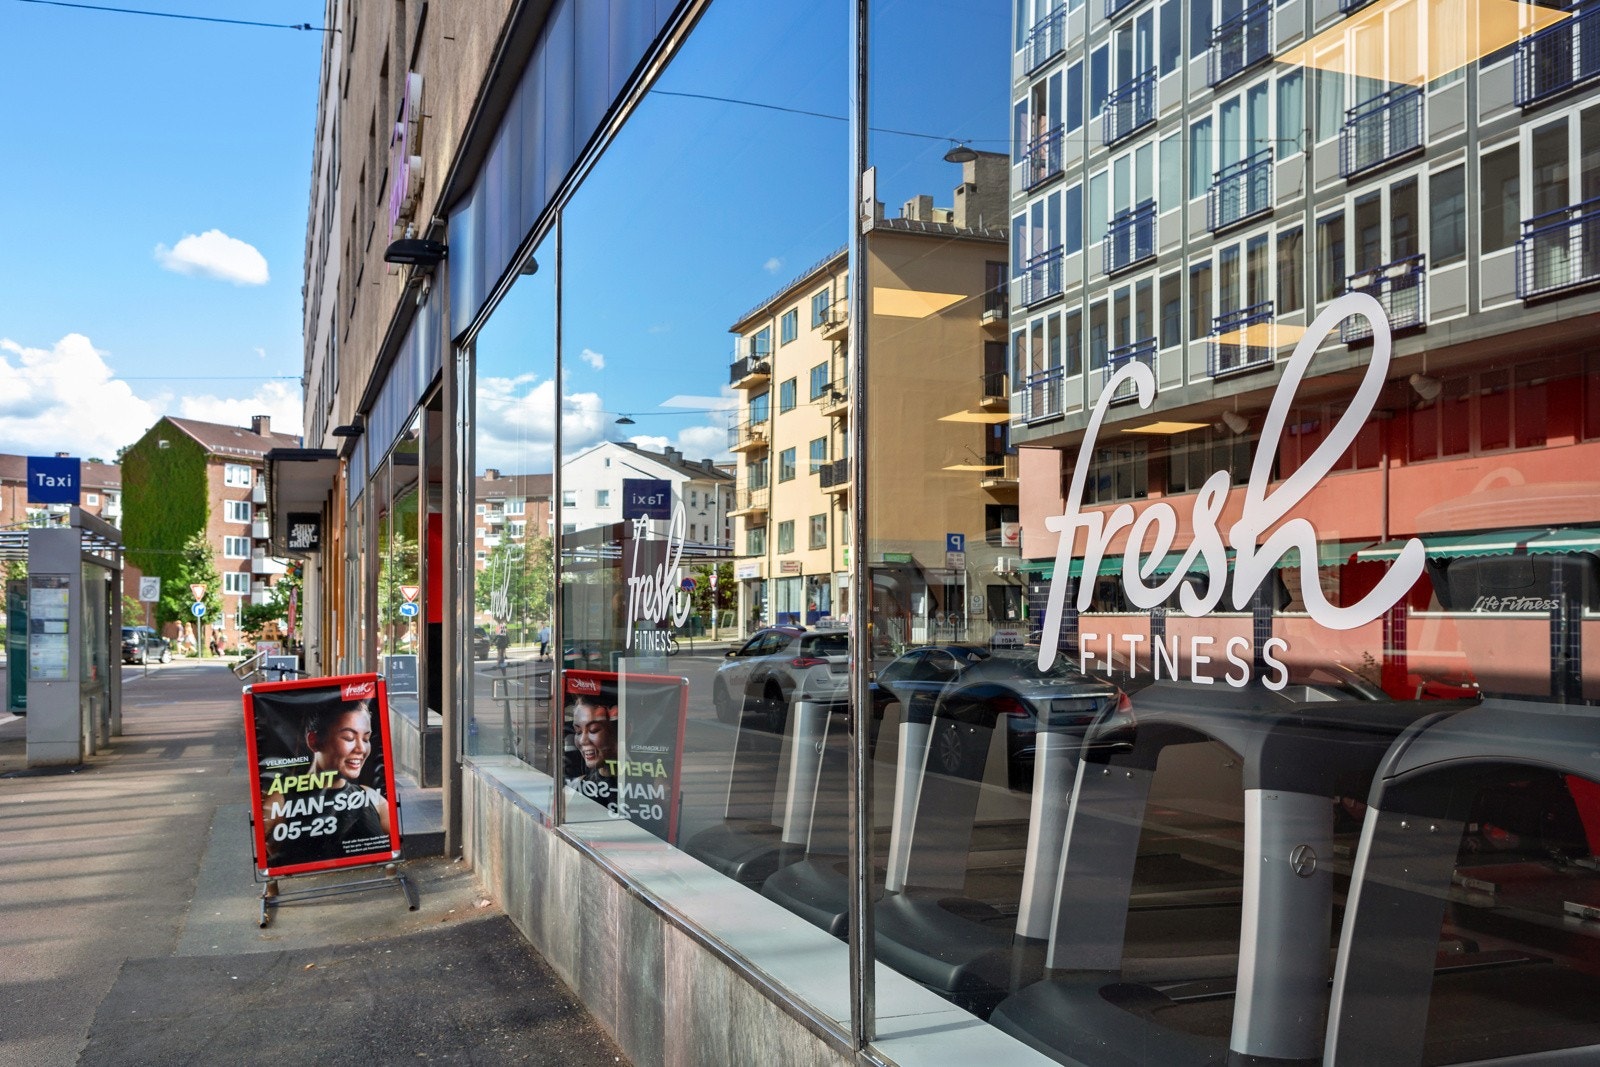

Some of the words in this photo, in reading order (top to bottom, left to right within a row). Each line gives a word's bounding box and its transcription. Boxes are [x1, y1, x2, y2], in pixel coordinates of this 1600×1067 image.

[36, 473, 72, 487] Taxi
[1037, 292, 1426, 673] fresh
[626, 500, 691, 650] fresh
[1471, 595, 1499, 614] Life
[1498, 596, 1560, 613] Fitness
[635, 630, 672, 652] FITNESS
[1080, 633, 1289, 691] FITNESS
[265, 756, 309, 767] VELKOMMEN
[268, 771, 338, 795] ÅPENT
[271, 788, 381, 819] MAN-SØN
[273, 816, 338, 841] 05-23
